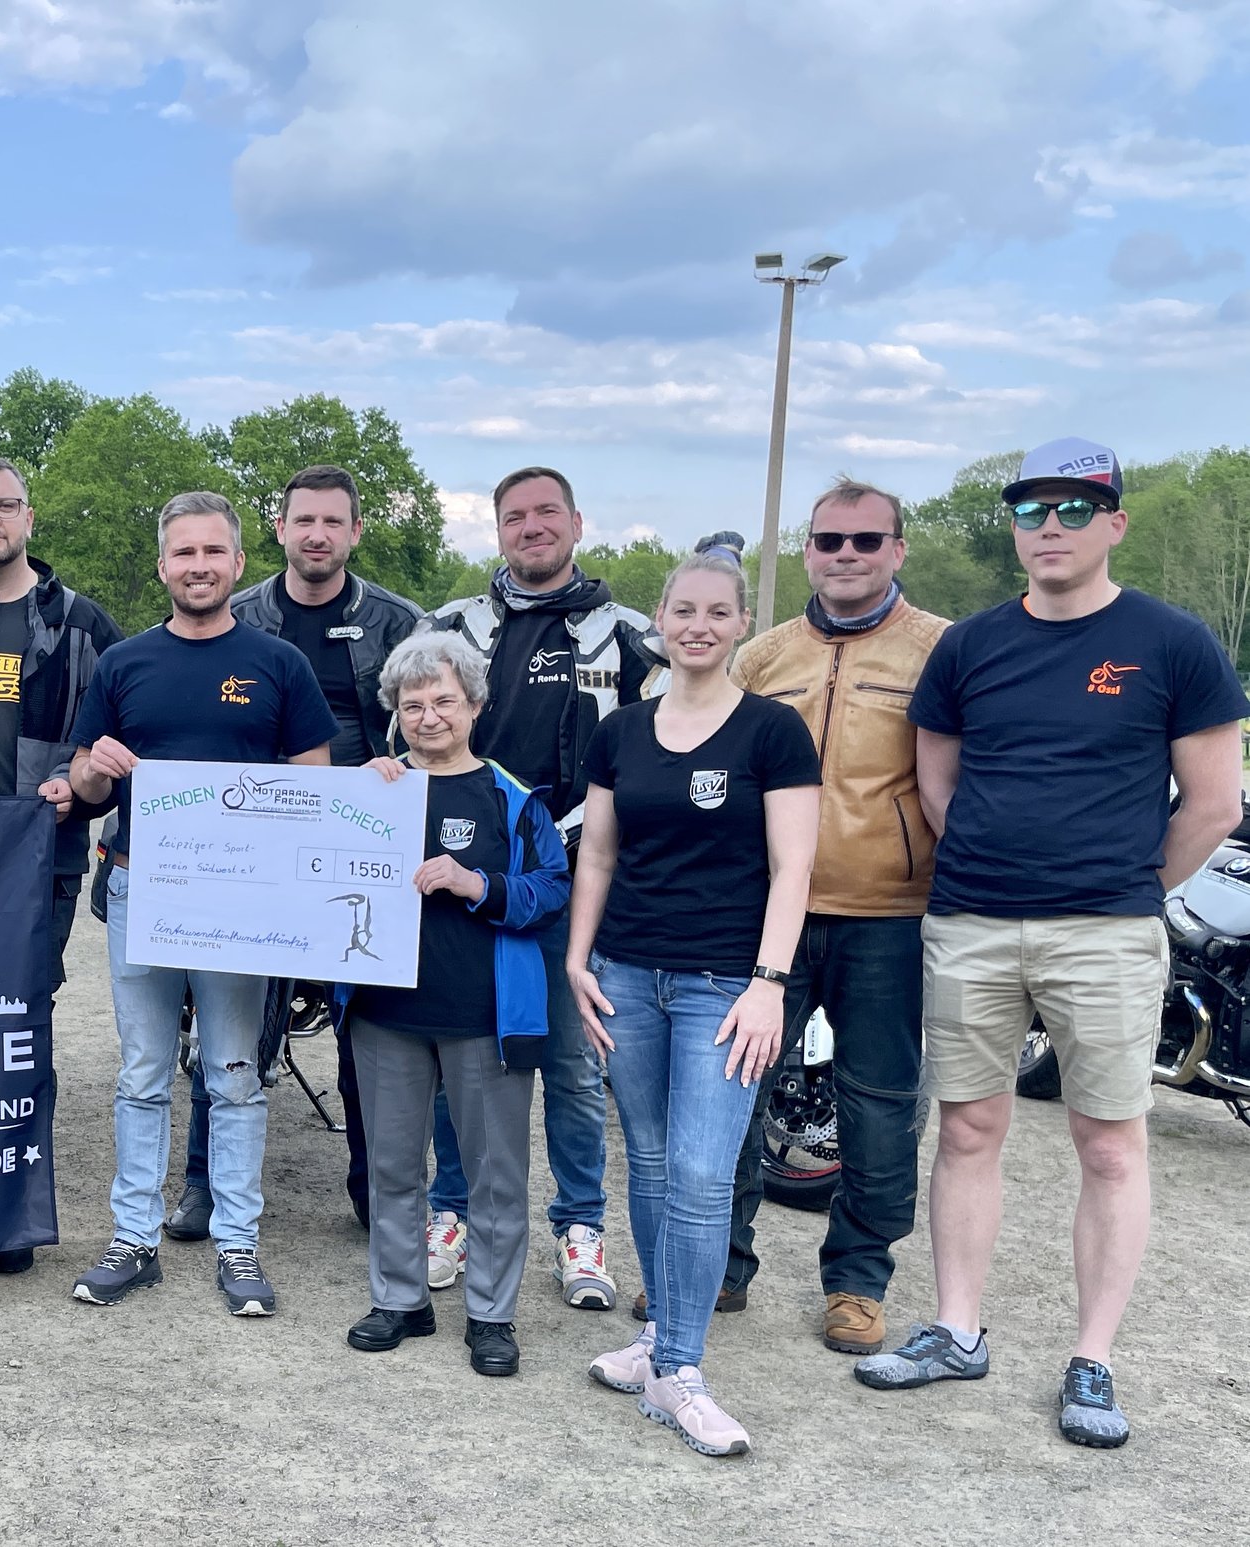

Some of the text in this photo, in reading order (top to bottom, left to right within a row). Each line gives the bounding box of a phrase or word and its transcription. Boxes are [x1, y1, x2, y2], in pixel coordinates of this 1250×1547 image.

[1057, 454, 1109, 474] RIDE
[537, 673, 559, 683] René
[229, 694, 251, 705] Hajo
[139, 785, 215, 816] SPENDEN
[274, 796, 321, 806] FREUNDE
[329, 798, 396, 840] SCHECK
[158, 835, 214, 854] Leipziger
[158, 861, 188, 871] verein
[311, 858, 322, 873] €
[150, 936, 179, 945] BETRAG
